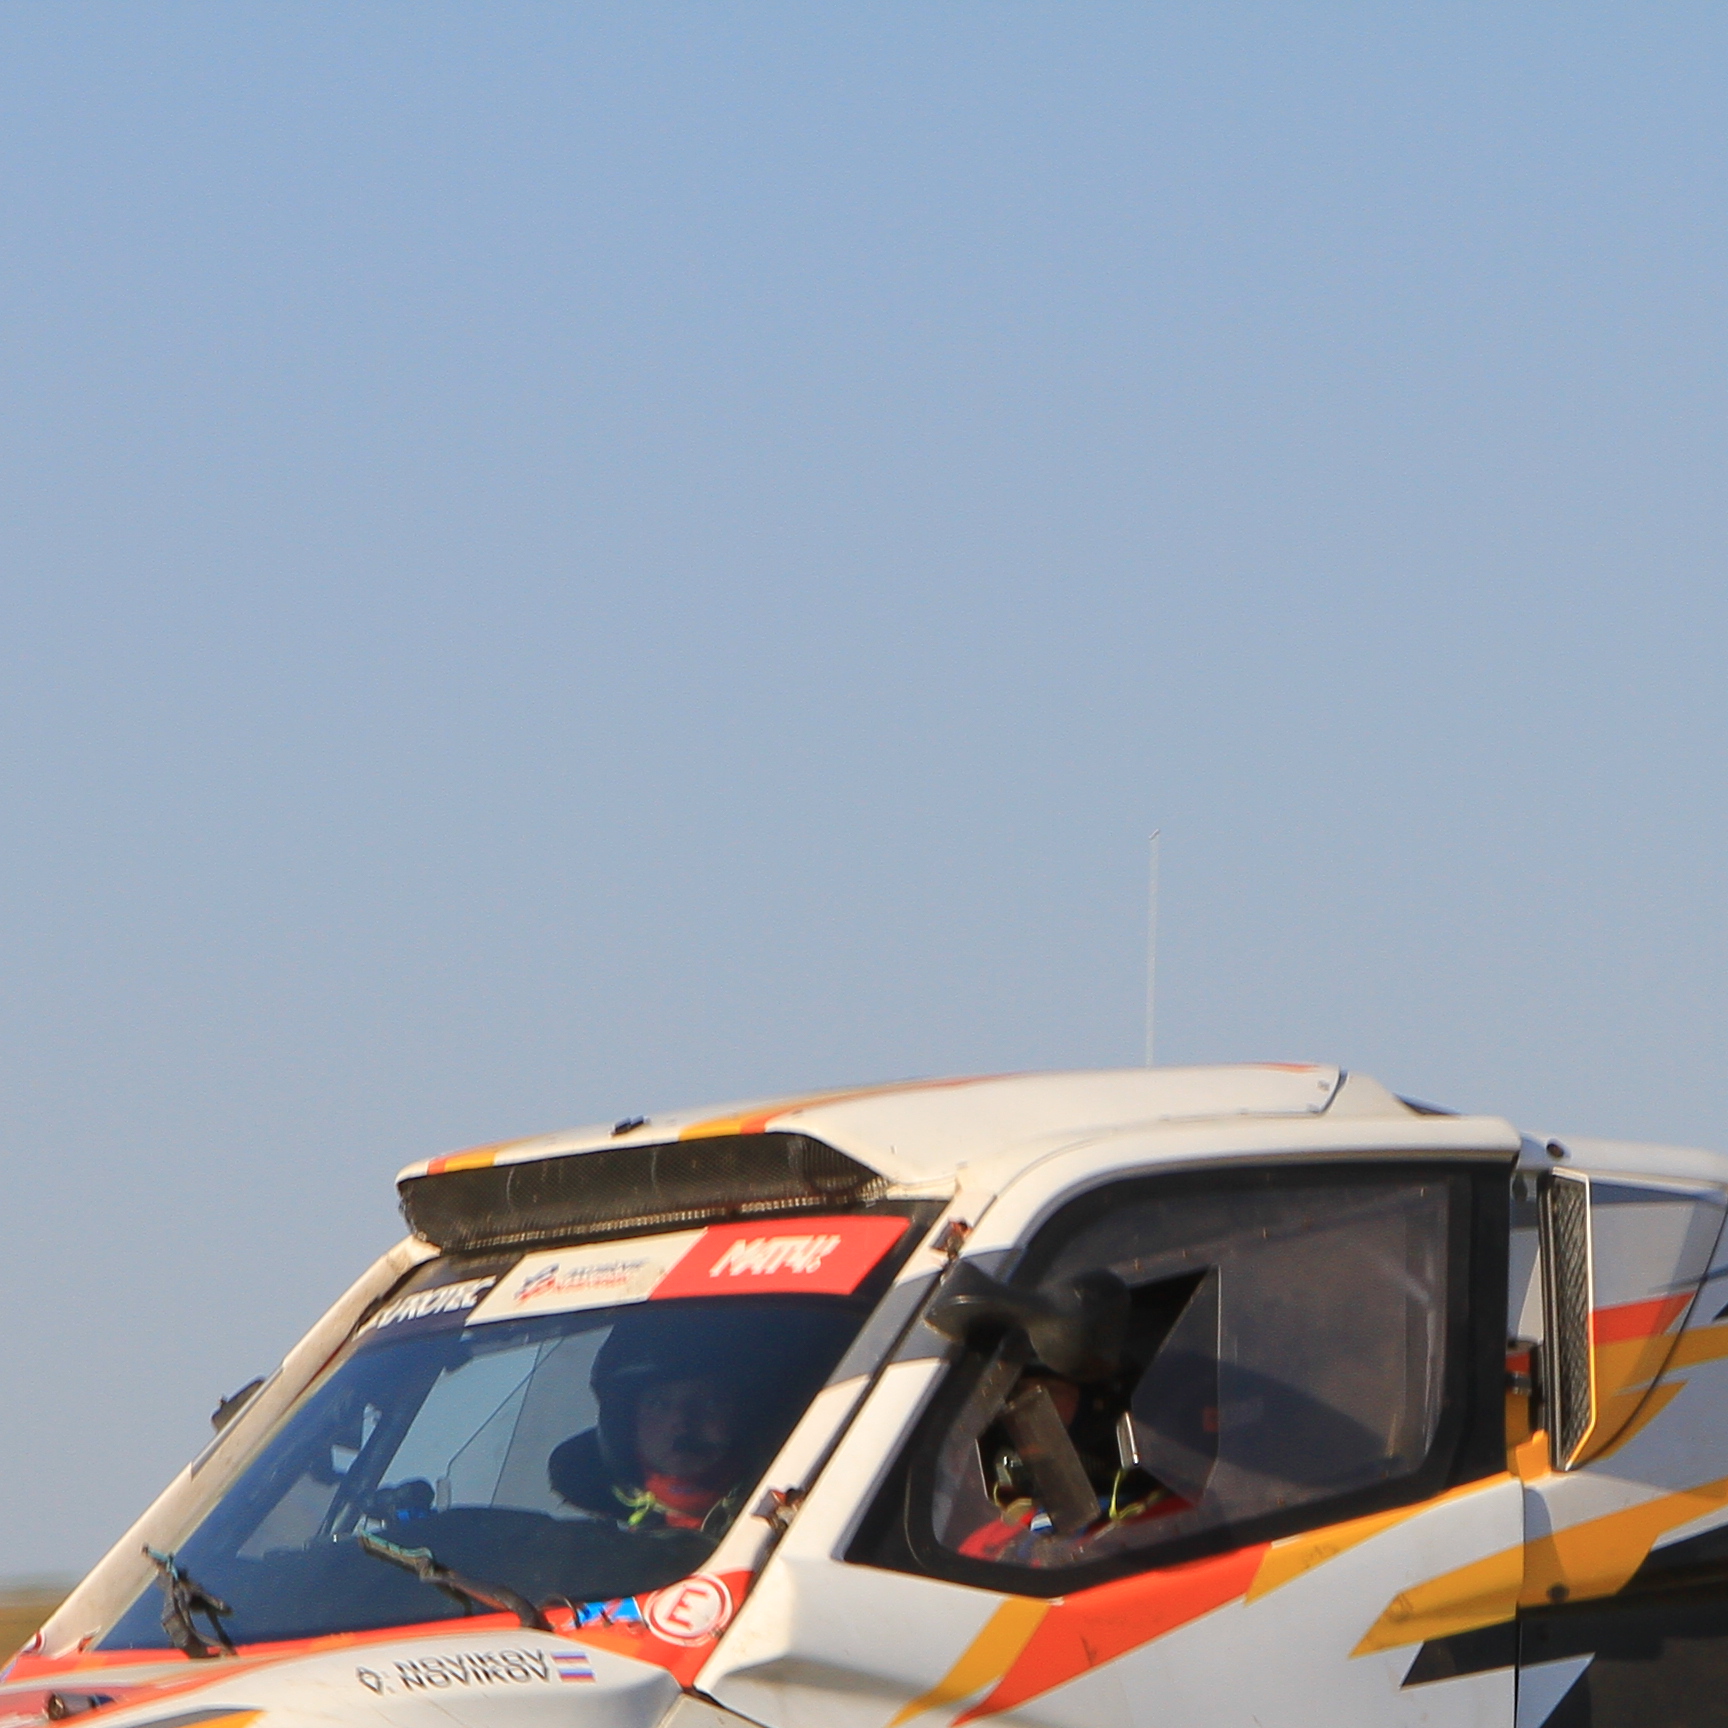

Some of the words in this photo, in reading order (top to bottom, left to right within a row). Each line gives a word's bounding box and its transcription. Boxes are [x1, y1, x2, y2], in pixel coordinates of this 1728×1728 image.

[665, 1586, 709, 1631] E
[393, 1648, 546, 1677] NOVIKOV
[398, 1663, 551, 1692] NOVIKOV
